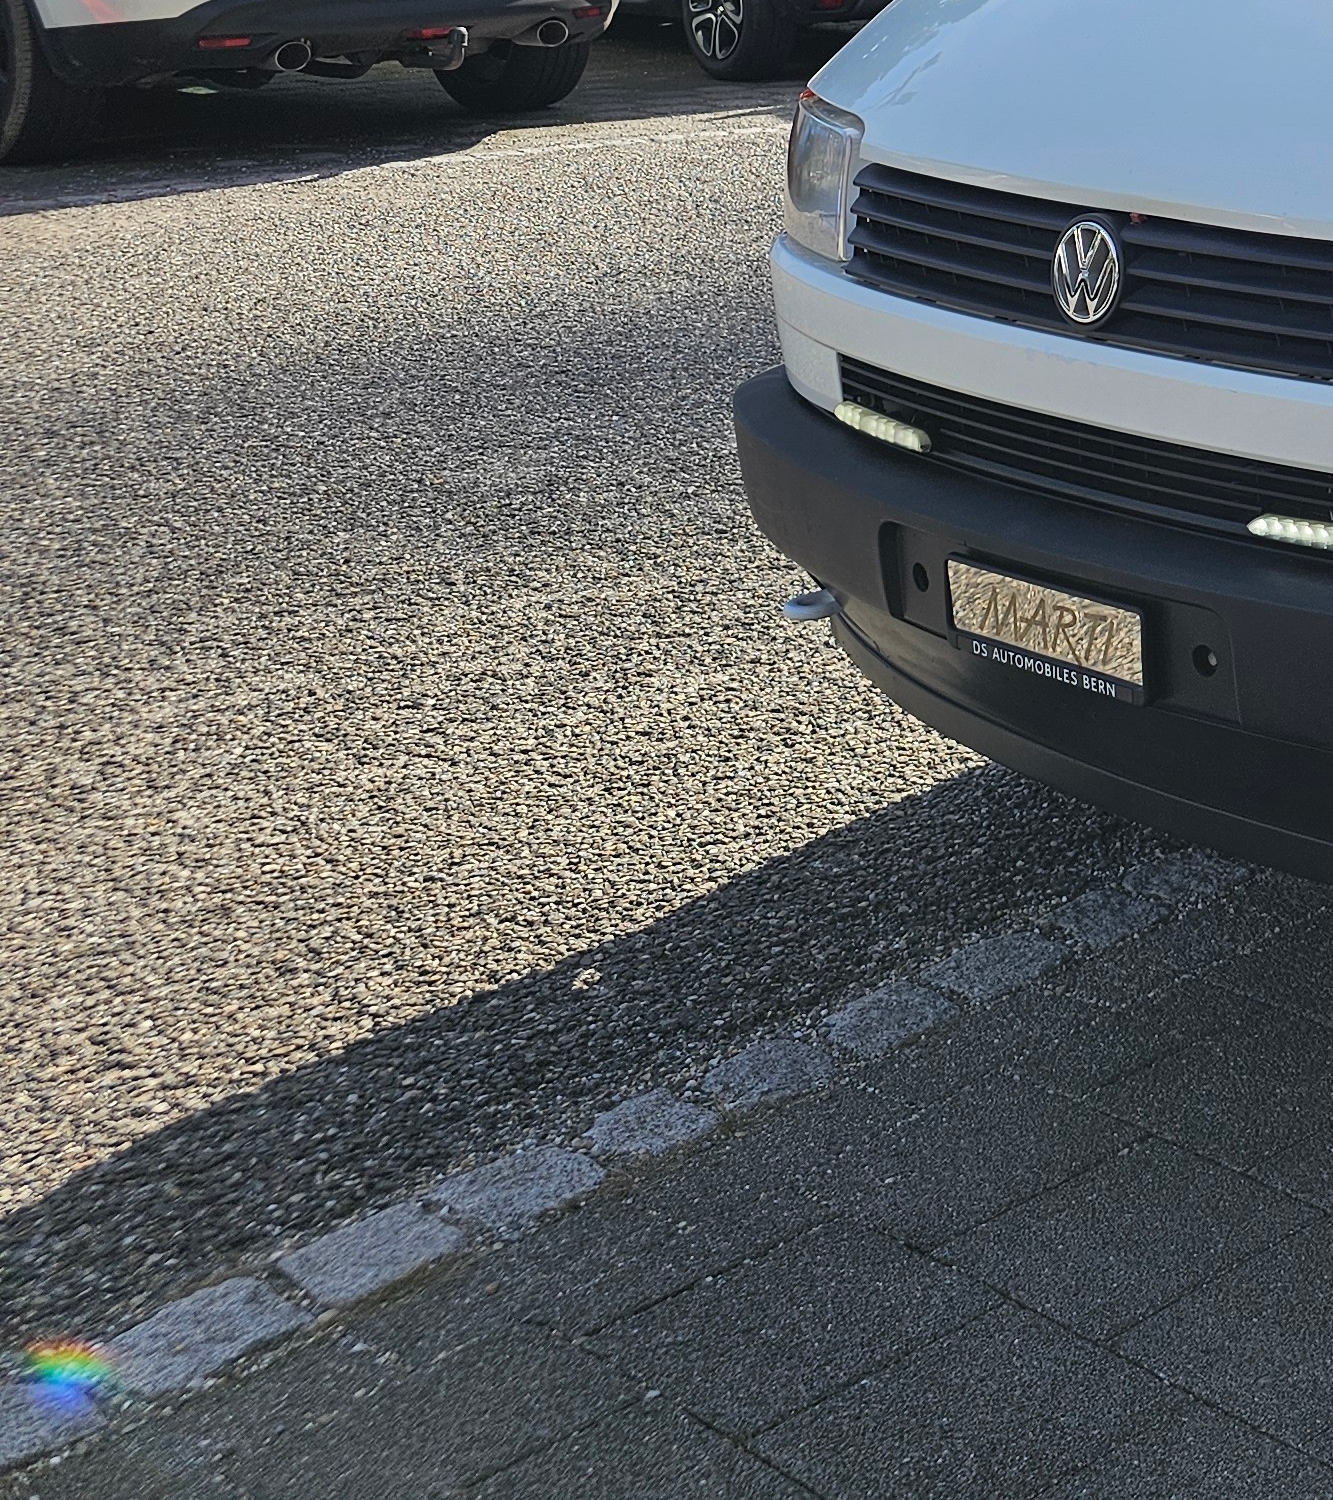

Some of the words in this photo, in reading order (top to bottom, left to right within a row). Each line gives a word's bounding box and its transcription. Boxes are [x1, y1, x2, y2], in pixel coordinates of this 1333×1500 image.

[972, 640, 988, 657] DS
[992, 647, 1078, 686] AUTOMOBILES
[1082, 674, 1116, 698] BERN
